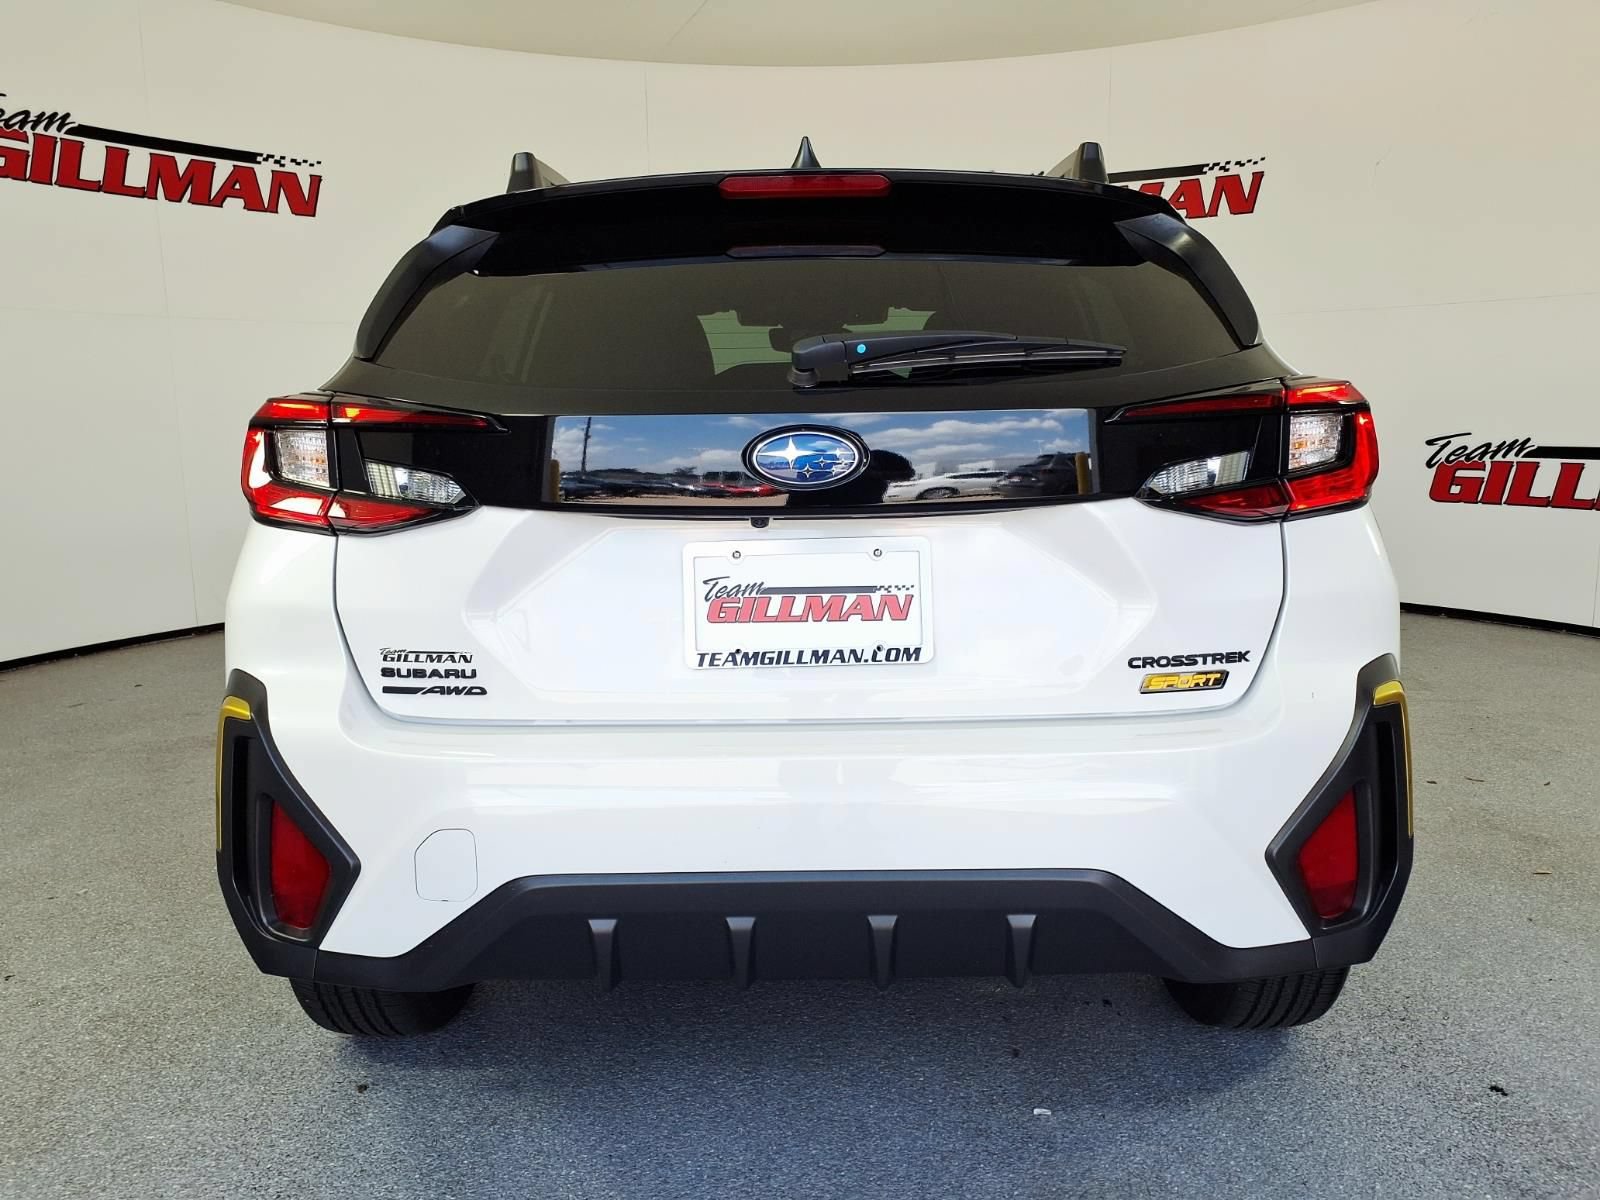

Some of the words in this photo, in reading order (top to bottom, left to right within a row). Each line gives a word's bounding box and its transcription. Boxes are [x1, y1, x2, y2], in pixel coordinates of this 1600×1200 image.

[0, 92, 76, 133] am
[1425, 432, 1535, 469] Team
[1429, 460, 1600, 511] GILL
[703, 576, 765, 602] Team
[707, 594, 914, 623] GILLMAN
[383, 653, 473, 663] GILLMAN
[697, 647, 922, 667] TEAMGILLMAN.COM
[1127, 650, 1251, 669] CROSSTREK
[380, 667, 477, 679] SUBARU
[1149, 673, 1221, 689] SPORT
[421, 686, 488, 695] AWD
